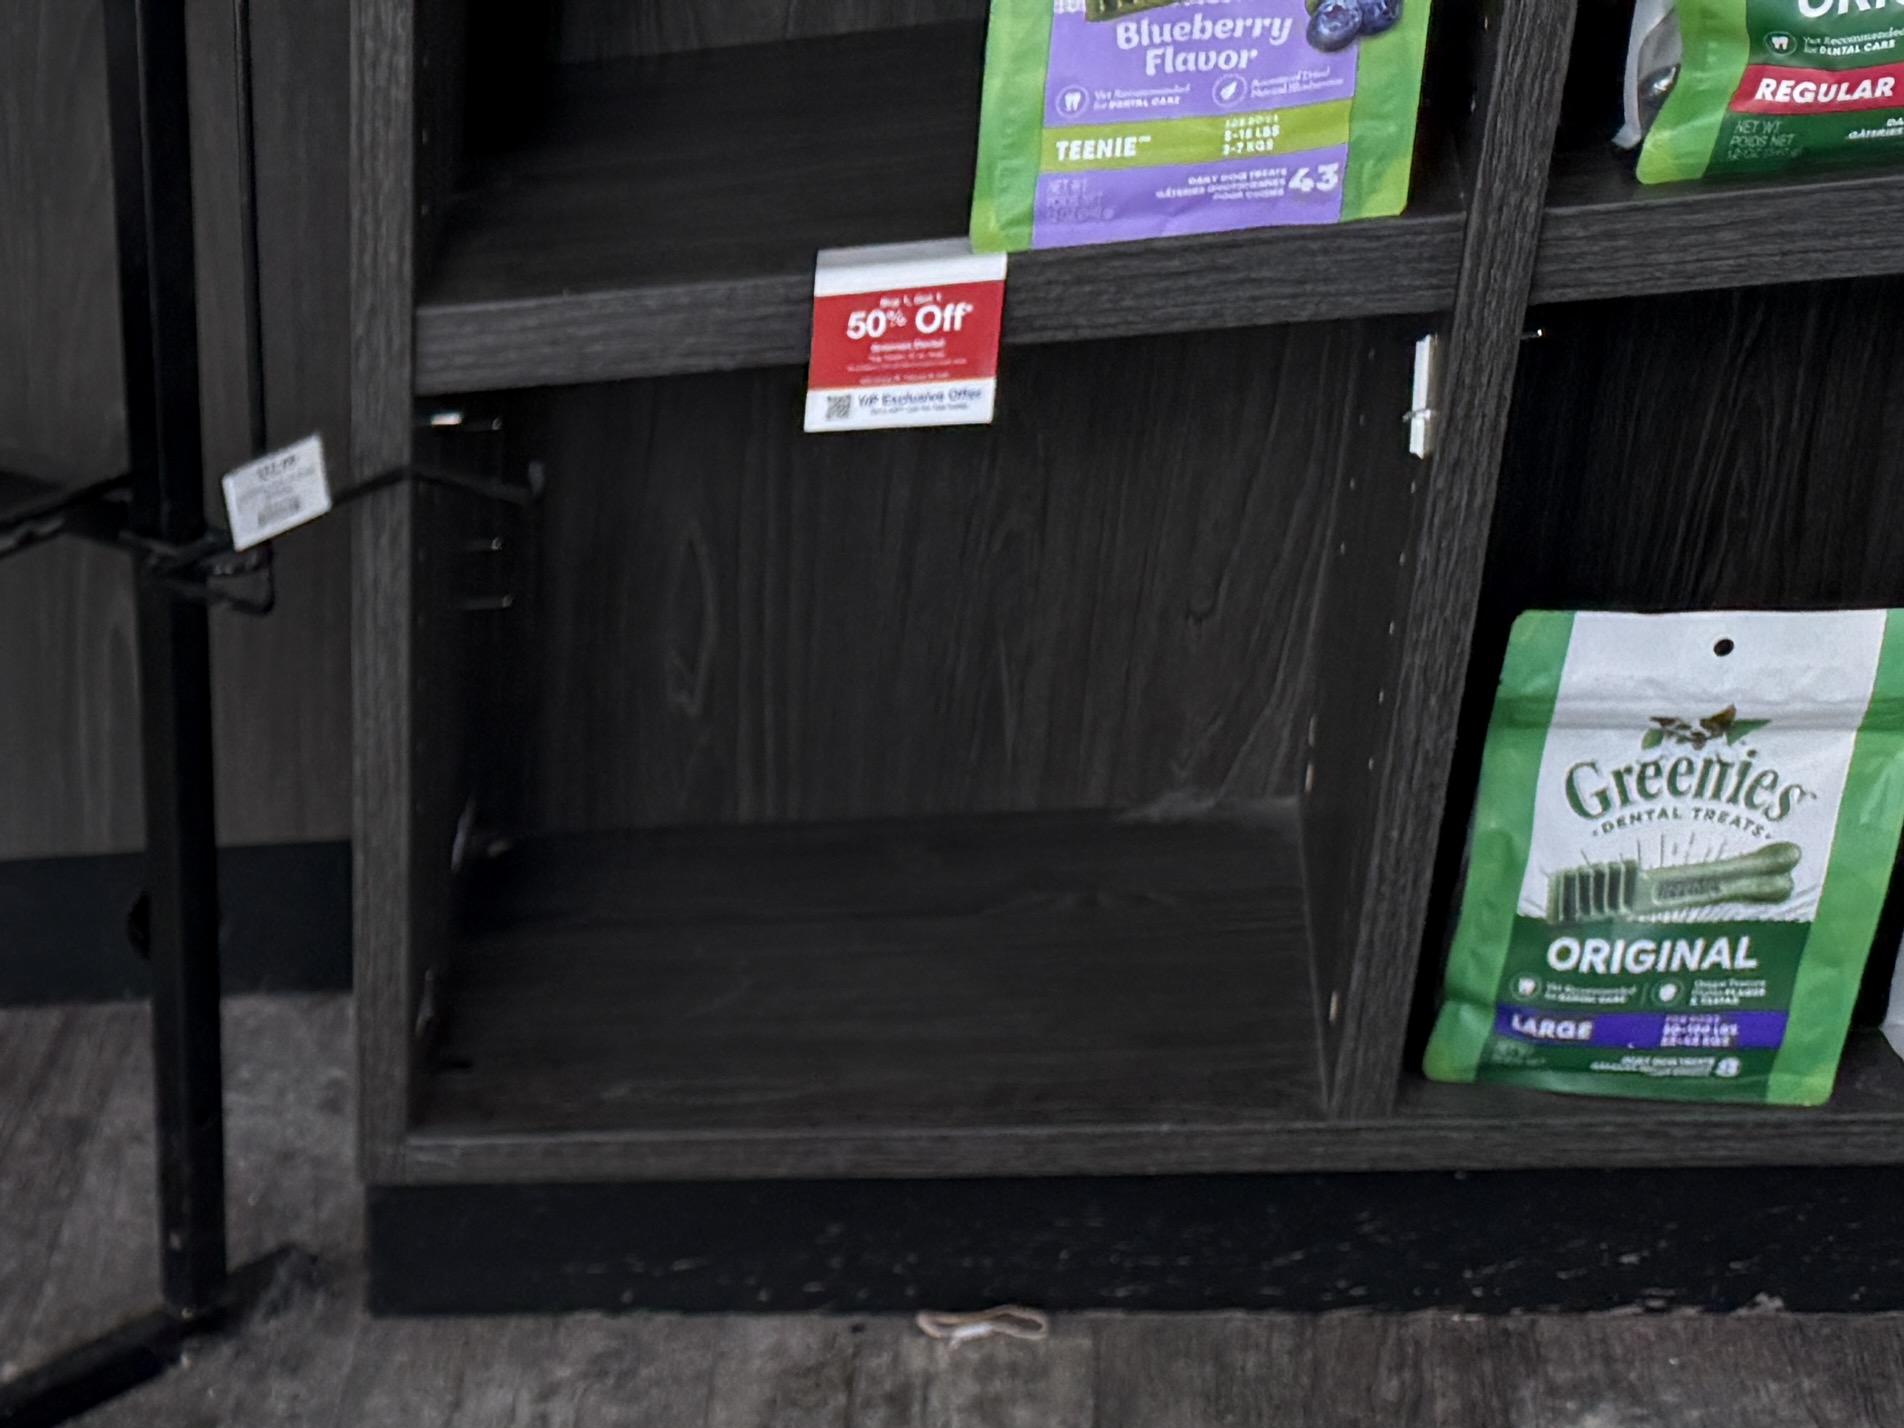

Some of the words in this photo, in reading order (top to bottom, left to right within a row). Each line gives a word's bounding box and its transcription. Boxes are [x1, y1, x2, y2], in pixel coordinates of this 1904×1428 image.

[1116, 13, 1293, 50] Blueberry
[1145, 46, 1258, 76] Flavor
[1754, 77, 1896, 103] REGULAR
[1055, 134, 1137, 162] TEENIE
[1288, 162, 1339, 192] 43
[846, 308, 907, 340] 50%
[1565, 750, 1806, 822] Greenies
[1600, 806, 1683, 835] DENTAL
[1691, 807, 1766, 837] TREATS
[1547, 936, 1759, 975] ORIGINAL
[1511, 1014, 1594, 1041] LARGE
